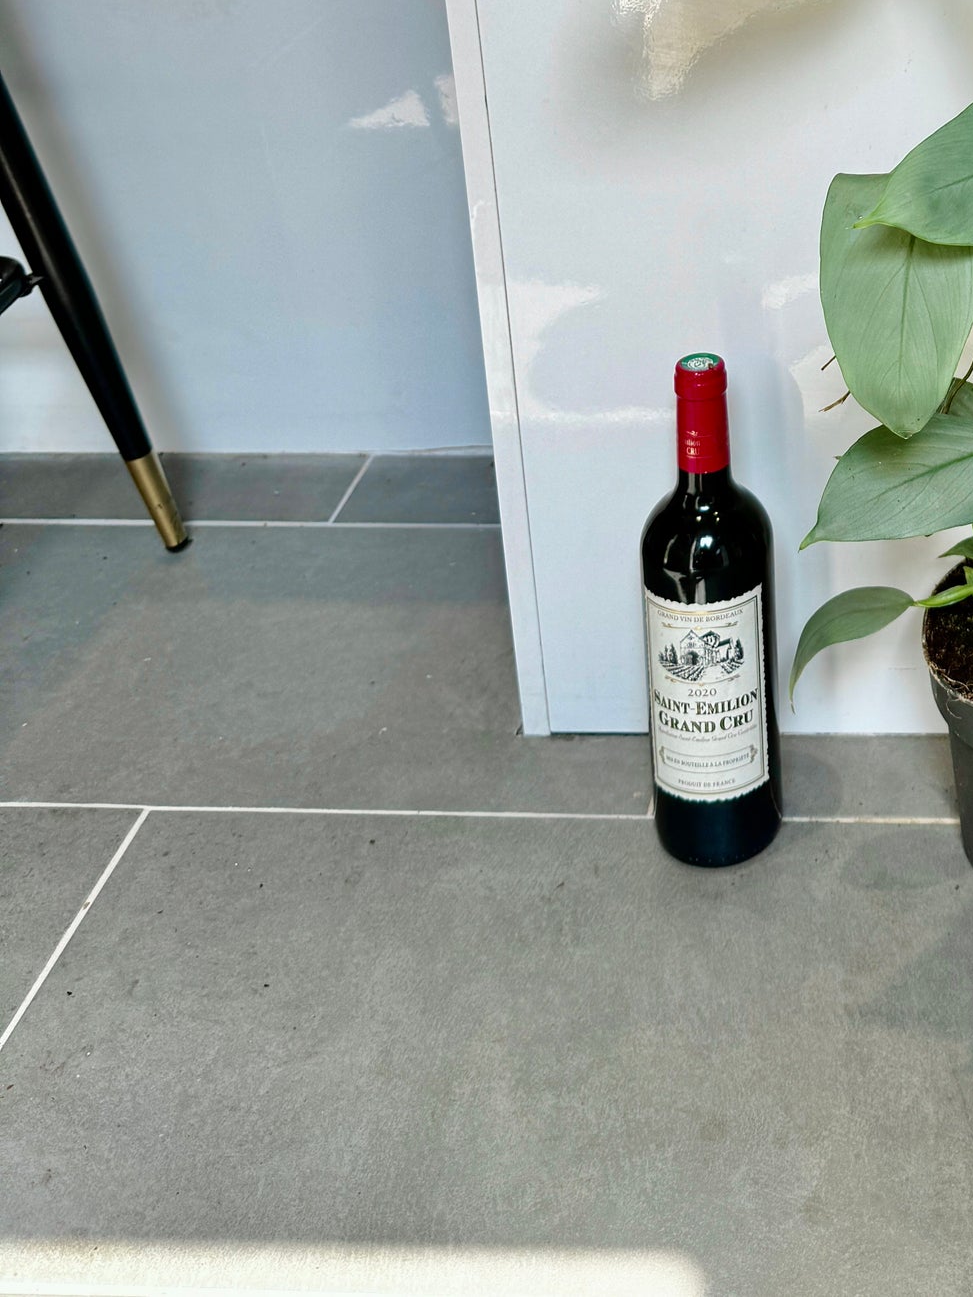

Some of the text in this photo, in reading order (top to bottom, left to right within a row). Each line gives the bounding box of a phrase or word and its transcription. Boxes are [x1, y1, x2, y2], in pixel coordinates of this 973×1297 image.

[657, 609, 678, 621] GRAND
[680, 614, 692, 622] VIN
[706, 608, 743, 622] BORDEAUX
[687, 687, 717, 697] 2020
[653, 687, 758, 716] SAINT-EMILION
[658, 709, 715, 733] GRAND
[719, 708, 753, 731] CRU
[681, 759, 709, 768] BOUTEILLE
[677, 778, 702, 787] PRODUIT
[712, 777, 736, 787] FRANCE
